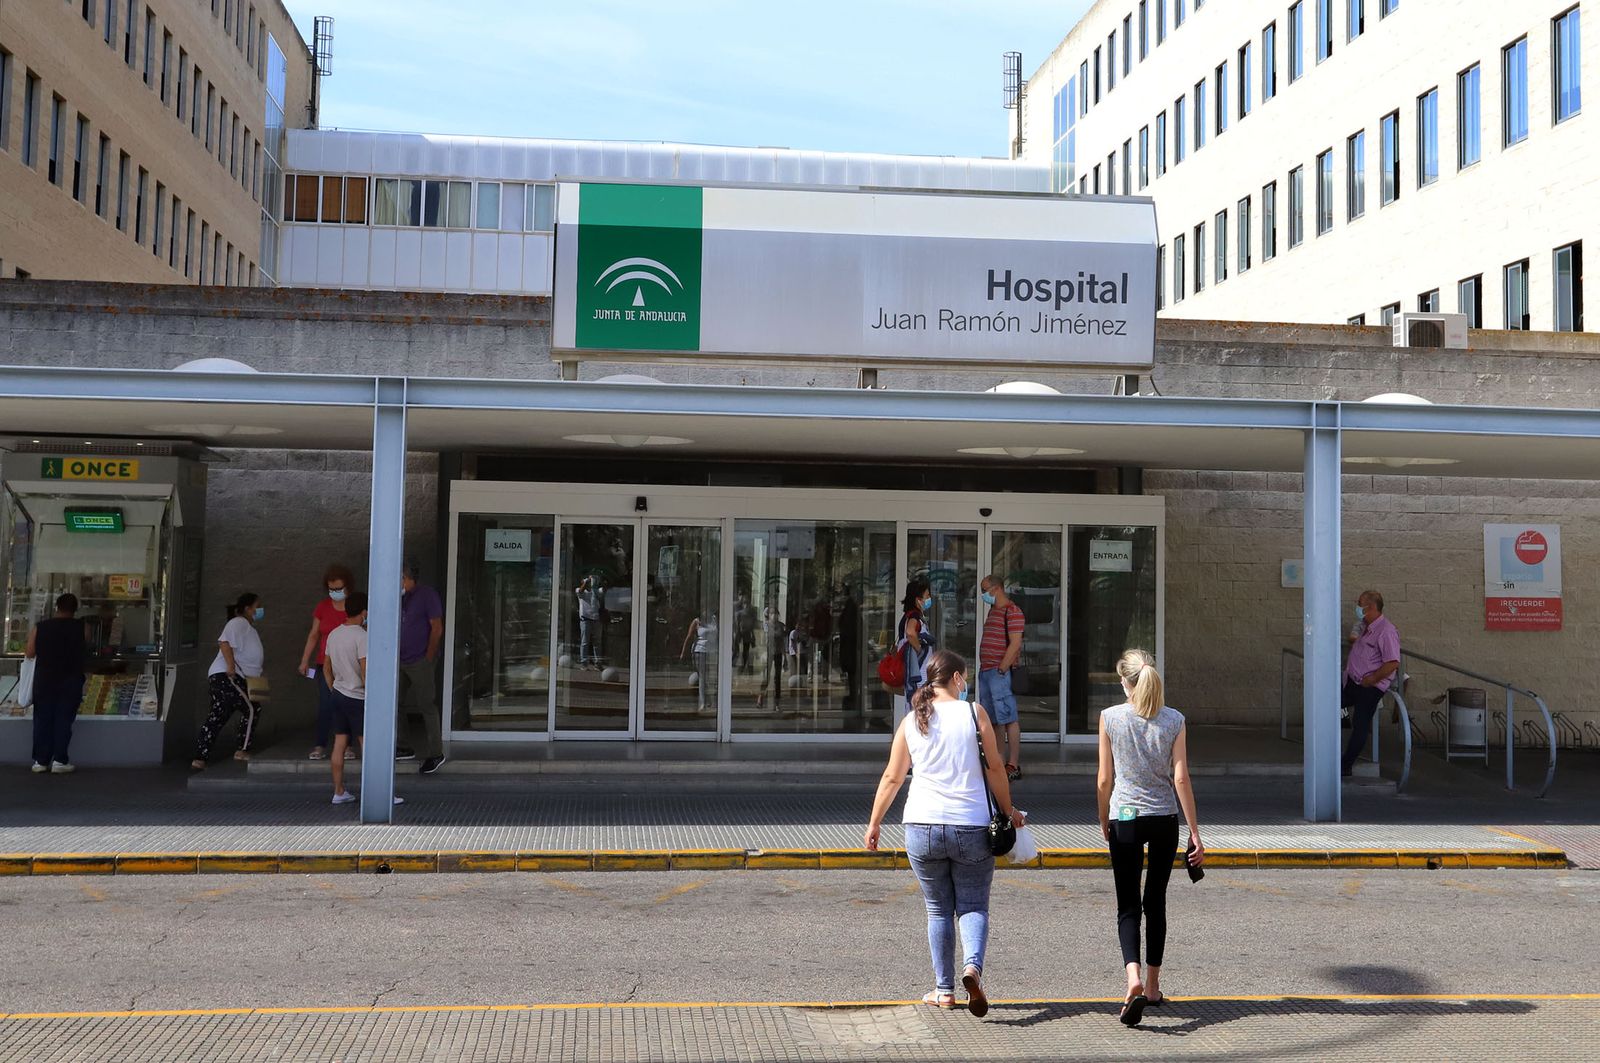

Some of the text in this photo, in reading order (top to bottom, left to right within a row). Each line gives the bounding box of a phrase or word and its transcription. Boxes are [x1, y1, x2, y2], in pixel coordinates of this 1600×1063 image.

[987, 269, 1128, 310] Hospital
[593, 309, 687, 322] JUNTA DE ANDALUCIA
[871, 307, 1127, 336] Juan Ramón Jiménez
[70, 461, 131, 477] ONCE
[1093, 552, 1129, 560] ENTRADA
[1503, 581, 1515, 590] sin
